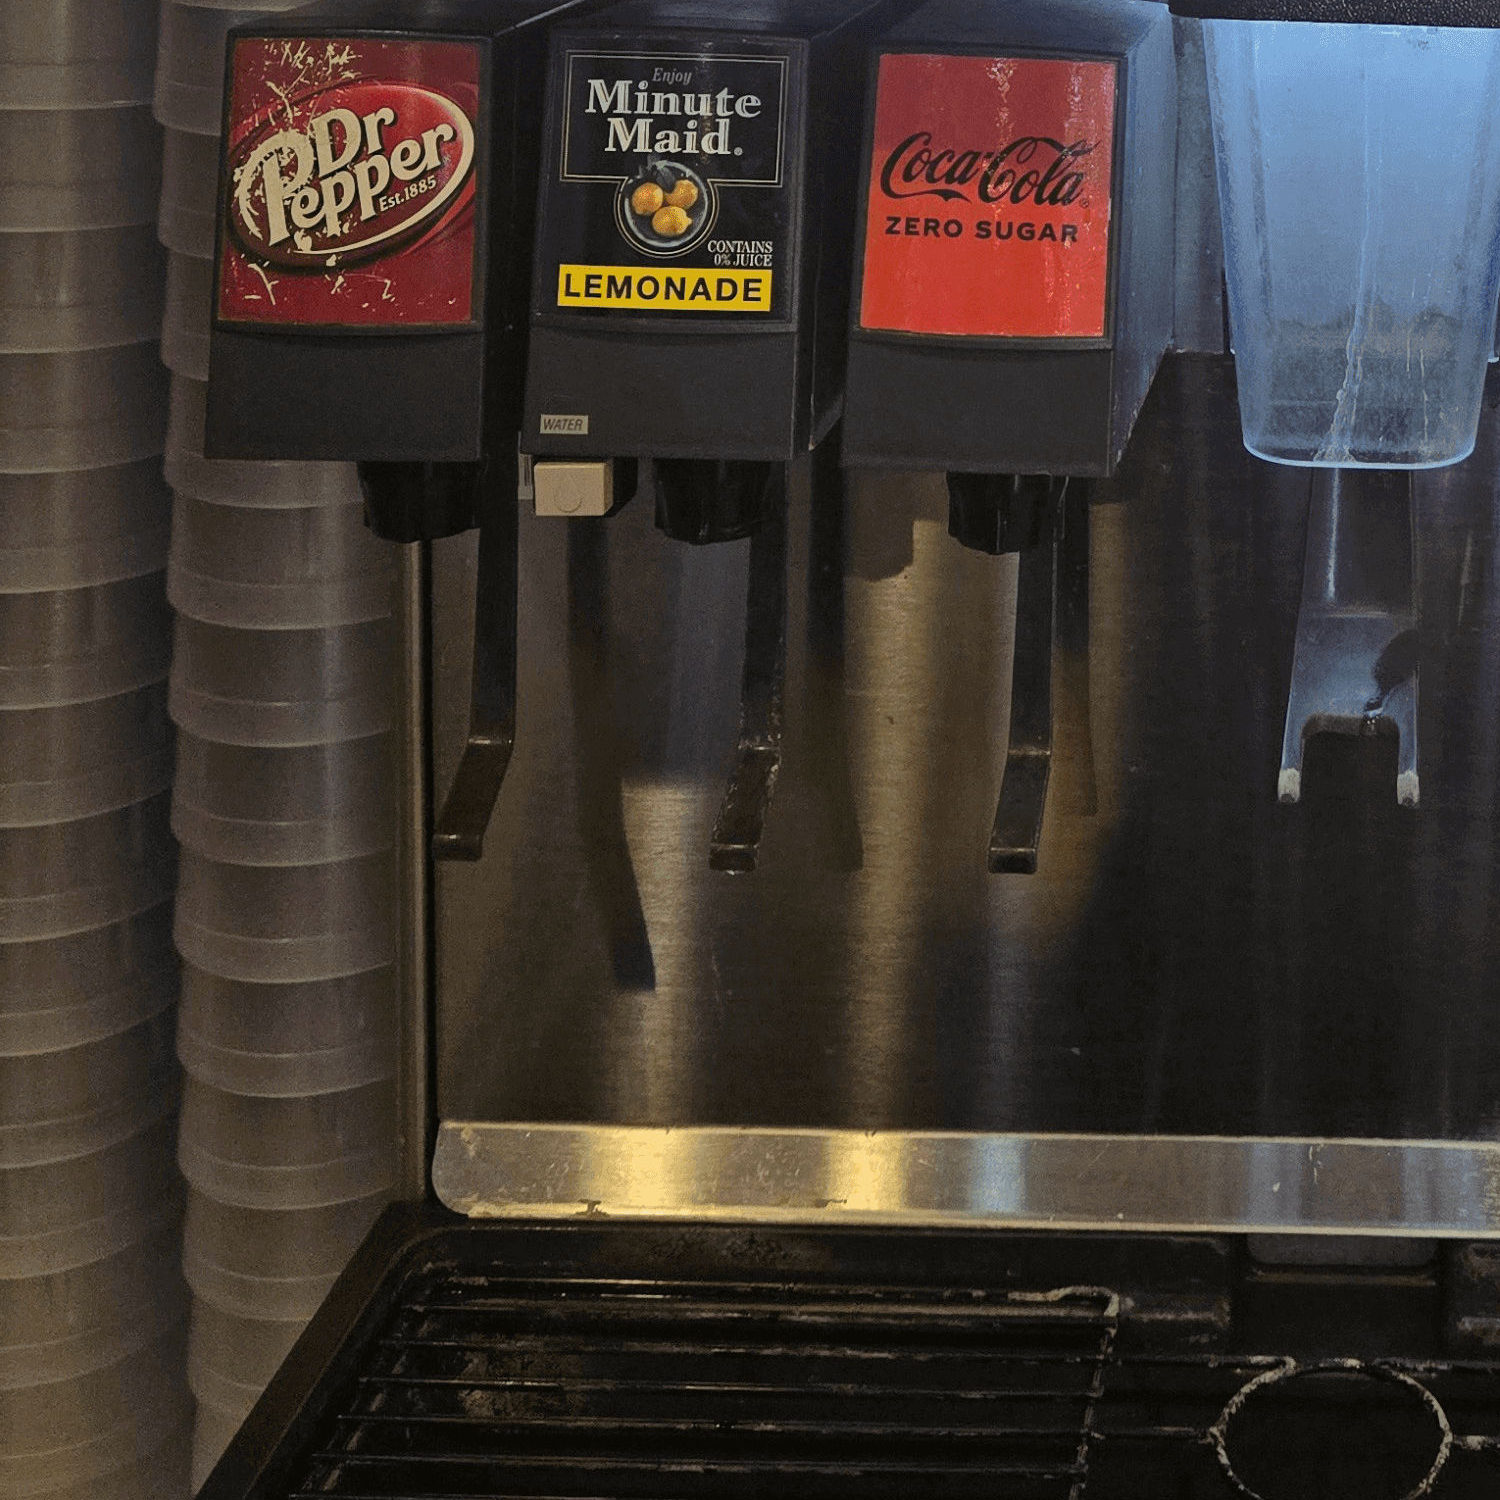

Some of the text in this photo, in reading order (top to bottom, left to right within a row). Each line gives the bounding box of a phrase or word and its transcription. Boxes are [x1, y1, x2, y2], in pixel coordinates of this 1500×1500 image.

[652, 67, 693, 85] Enjoy
[585, 78, 762, 118] Minute
[310, 107, 395, 178] Dr
[604, 117, 732, 155] Maid
[880, 131, 1100, 207] Coca-Cola
[234, 123, 454, 246] Pepper
[884, 215, 1079, 243] ZERO SUGAR
[707, 239, 774, 254] CONTAINS
[714, 253, 773, 267] 0% JUICE
[564, 273, 763, 302] LEMONADE
[543, 418, 583, 431] WATER
